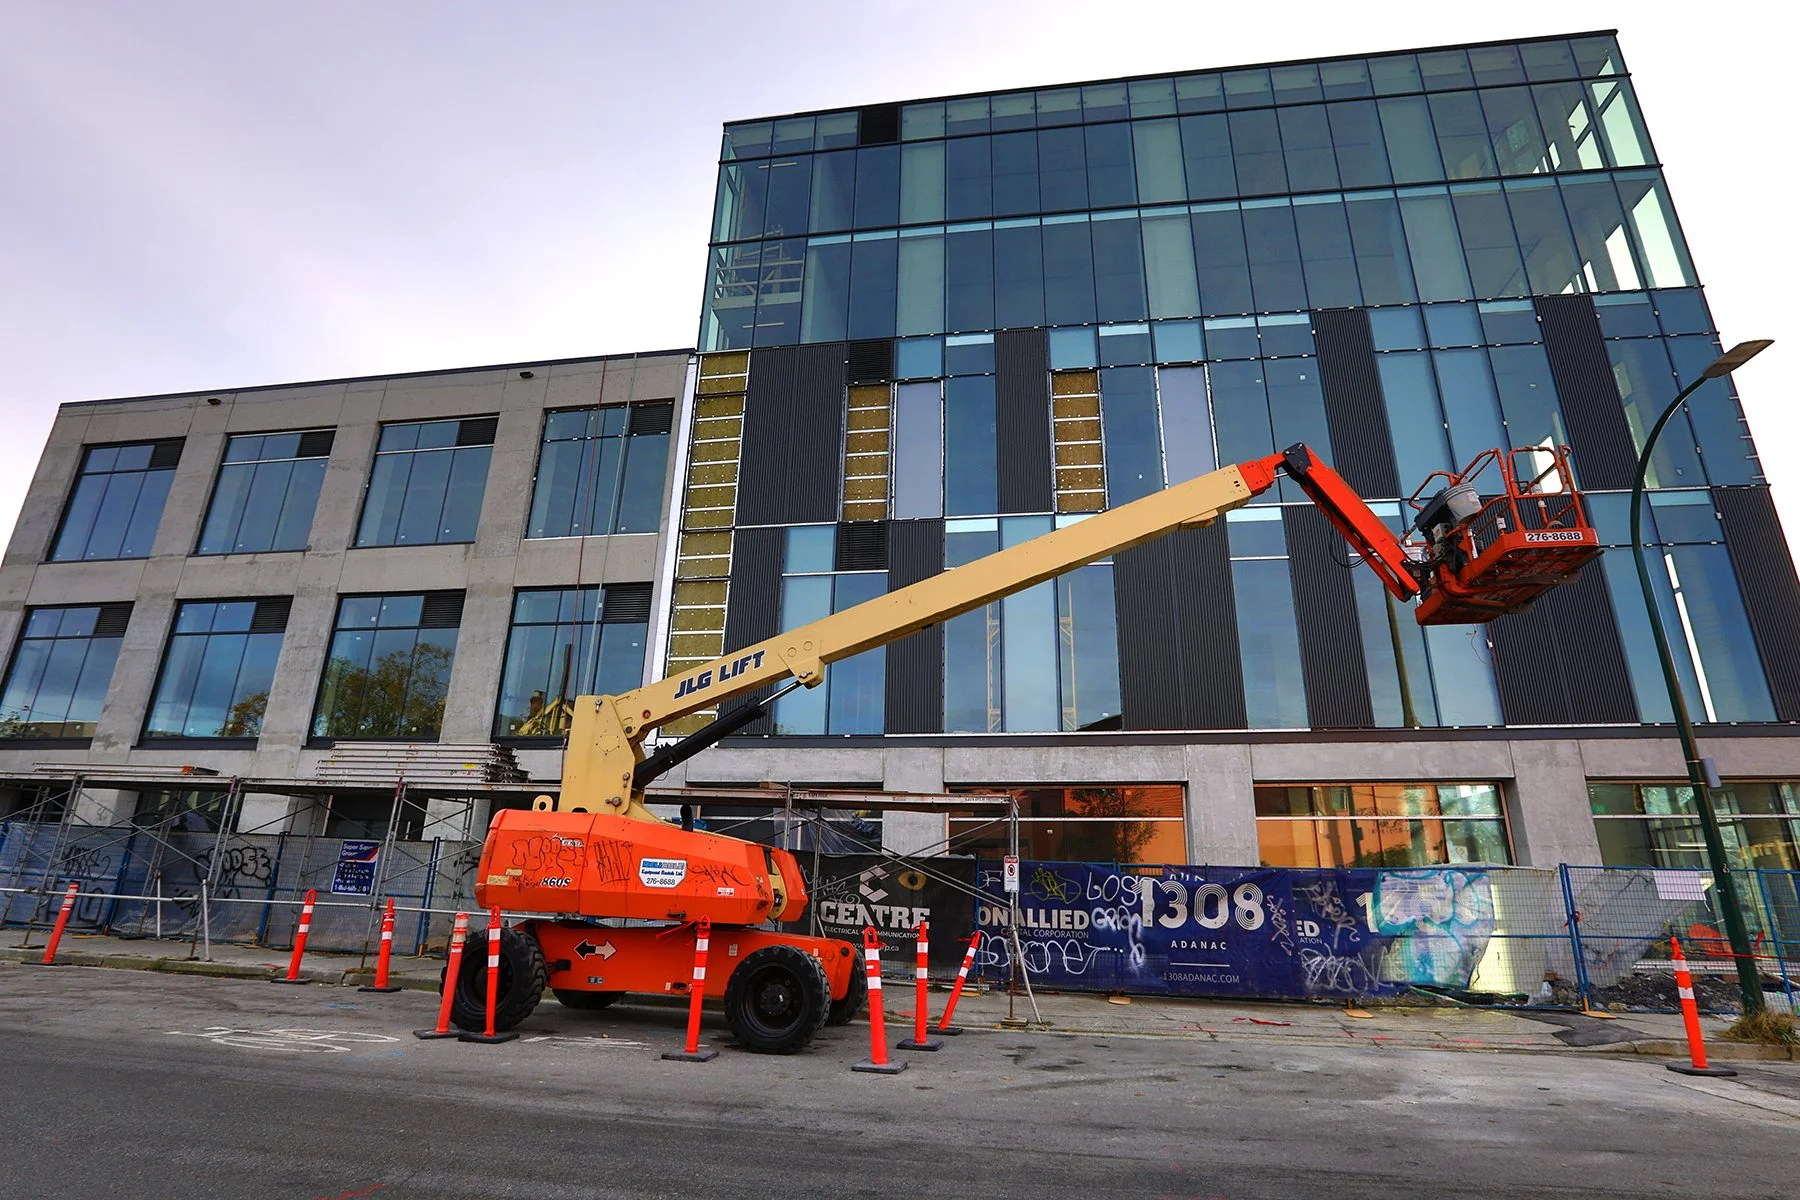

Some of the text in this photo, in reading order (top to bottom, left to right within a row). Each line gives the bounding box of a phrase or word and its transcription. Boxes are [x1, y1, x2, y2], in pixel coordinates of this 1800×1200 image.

[1527, 531, 1582, 542] 276-8688
[673, 649, 765, 700] JLG LIFT
[646, 877, 676, 885] 276-8688
[1130, 877, 1265, 931] 1308
[820, 900, 931, 930] CENTRE
[824, 925, 859, 935] ELECTRICAL
[1033, 929, 1089, 939] CORPORATION
[1170, 939, 1228, 951] ADANAC
[1163, 972, 1240, 984] 1308ADANAC.COM
